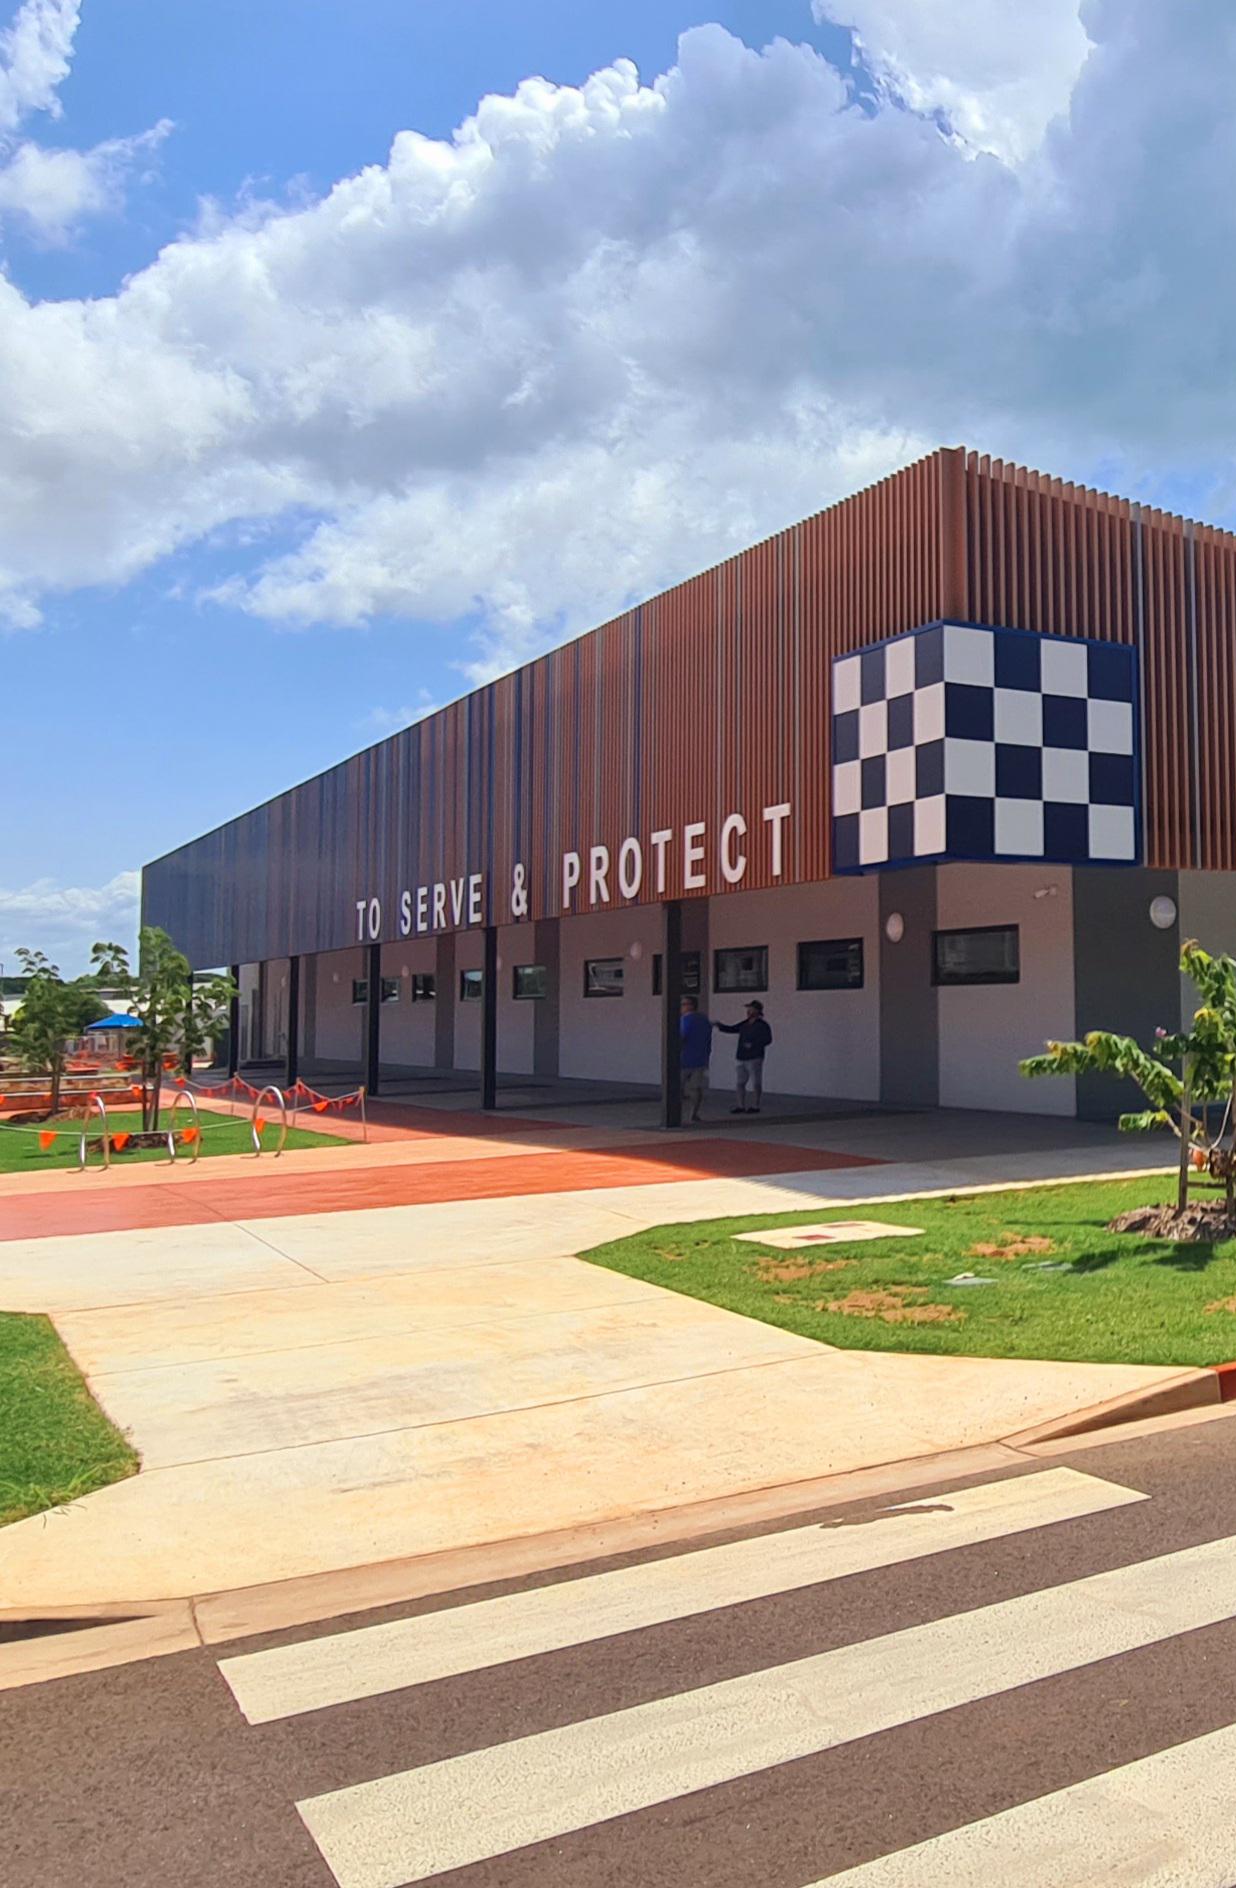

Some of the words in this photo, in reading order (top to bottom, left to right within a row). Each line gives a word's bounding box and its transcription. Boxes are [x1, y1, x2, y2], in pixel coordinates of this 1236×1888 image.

[356, 898, 381, 940] TO
[401, 873, 483, 935] SERVE
[511, 862, 529, 917] &
[562, 802, 791, 909] PROTECT
